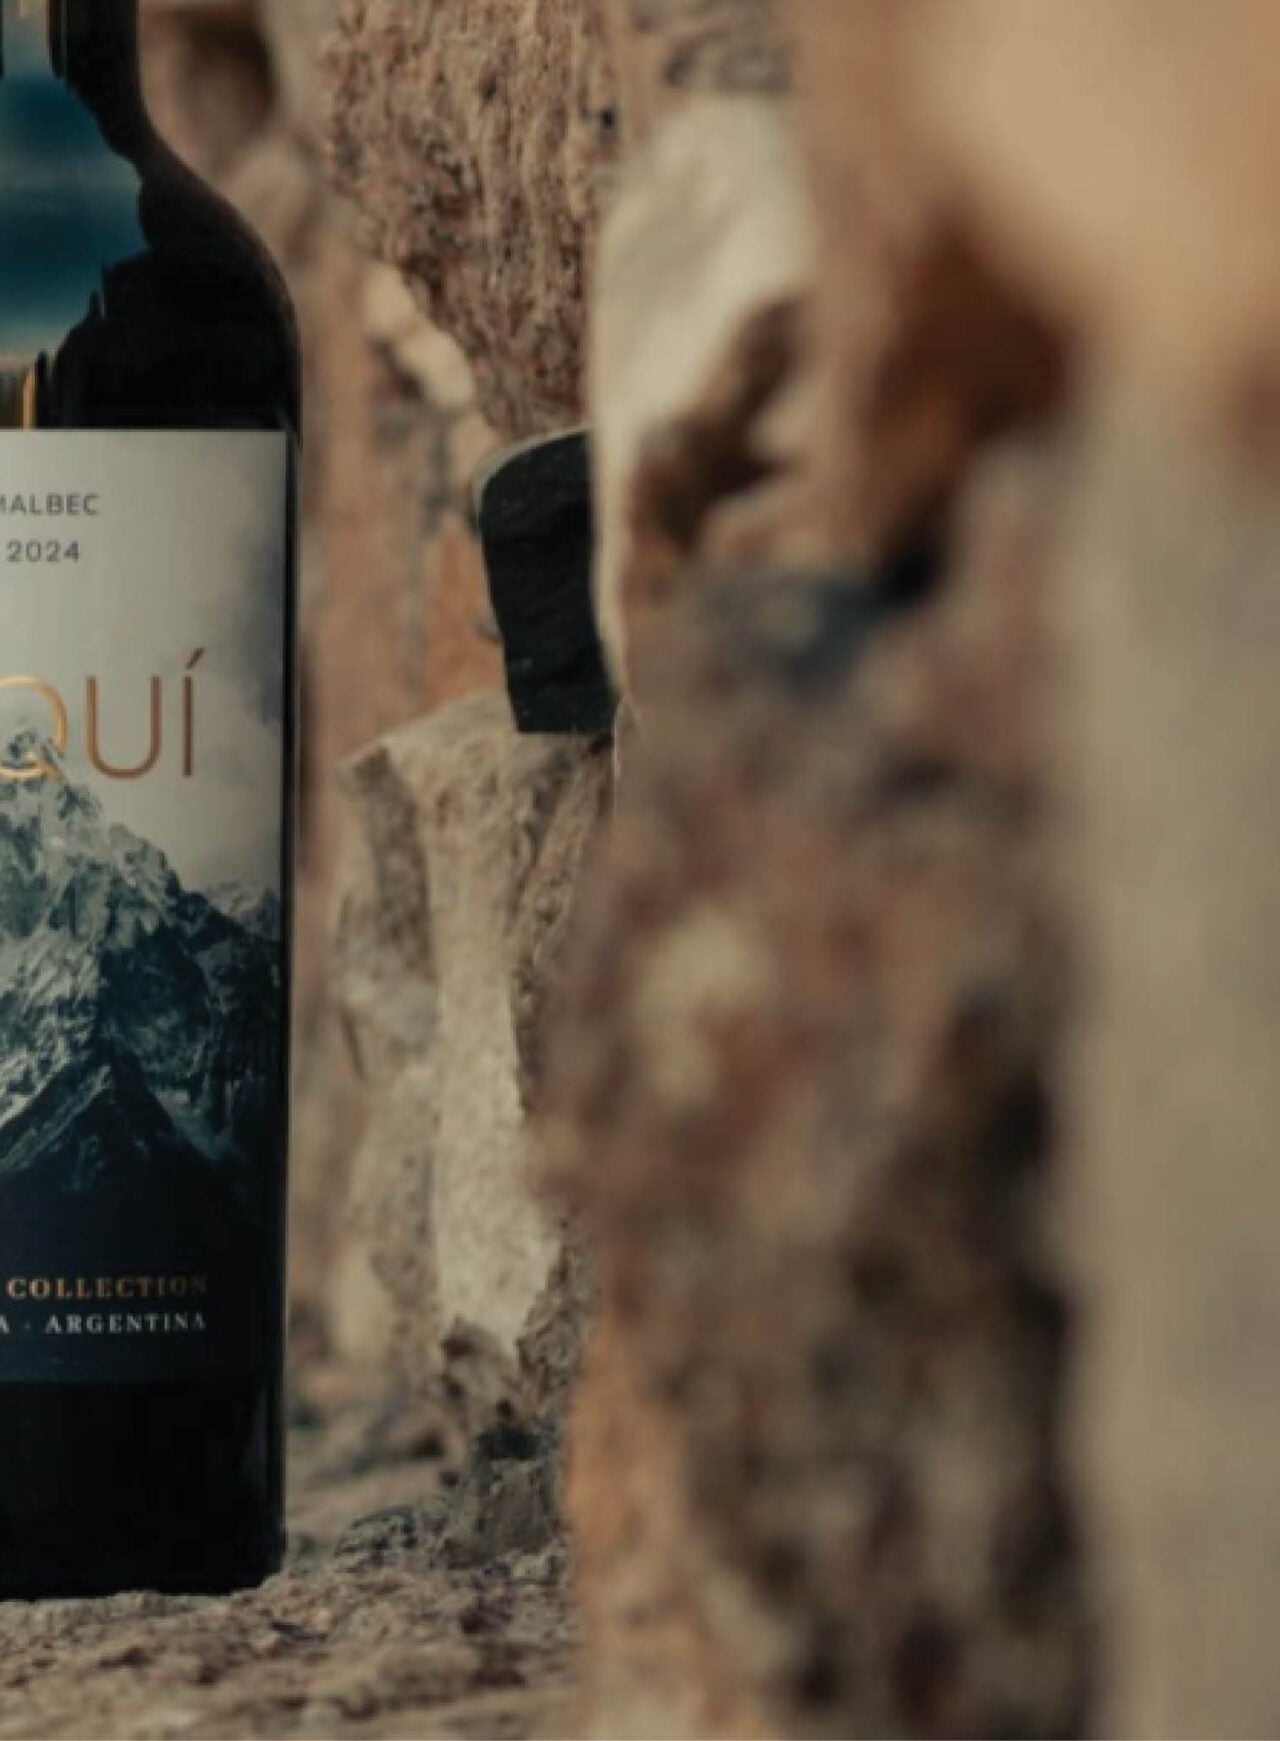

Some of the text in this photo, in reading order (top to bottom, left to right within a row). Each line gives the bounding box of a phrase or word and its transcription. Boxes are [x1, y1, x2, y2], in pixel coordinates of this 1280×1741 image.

[7, 541, 80, 563] 2024
[7, 1275, 207, 1300] COLLECTION
[45, 1311, 206, 1335] ARGENTINA
